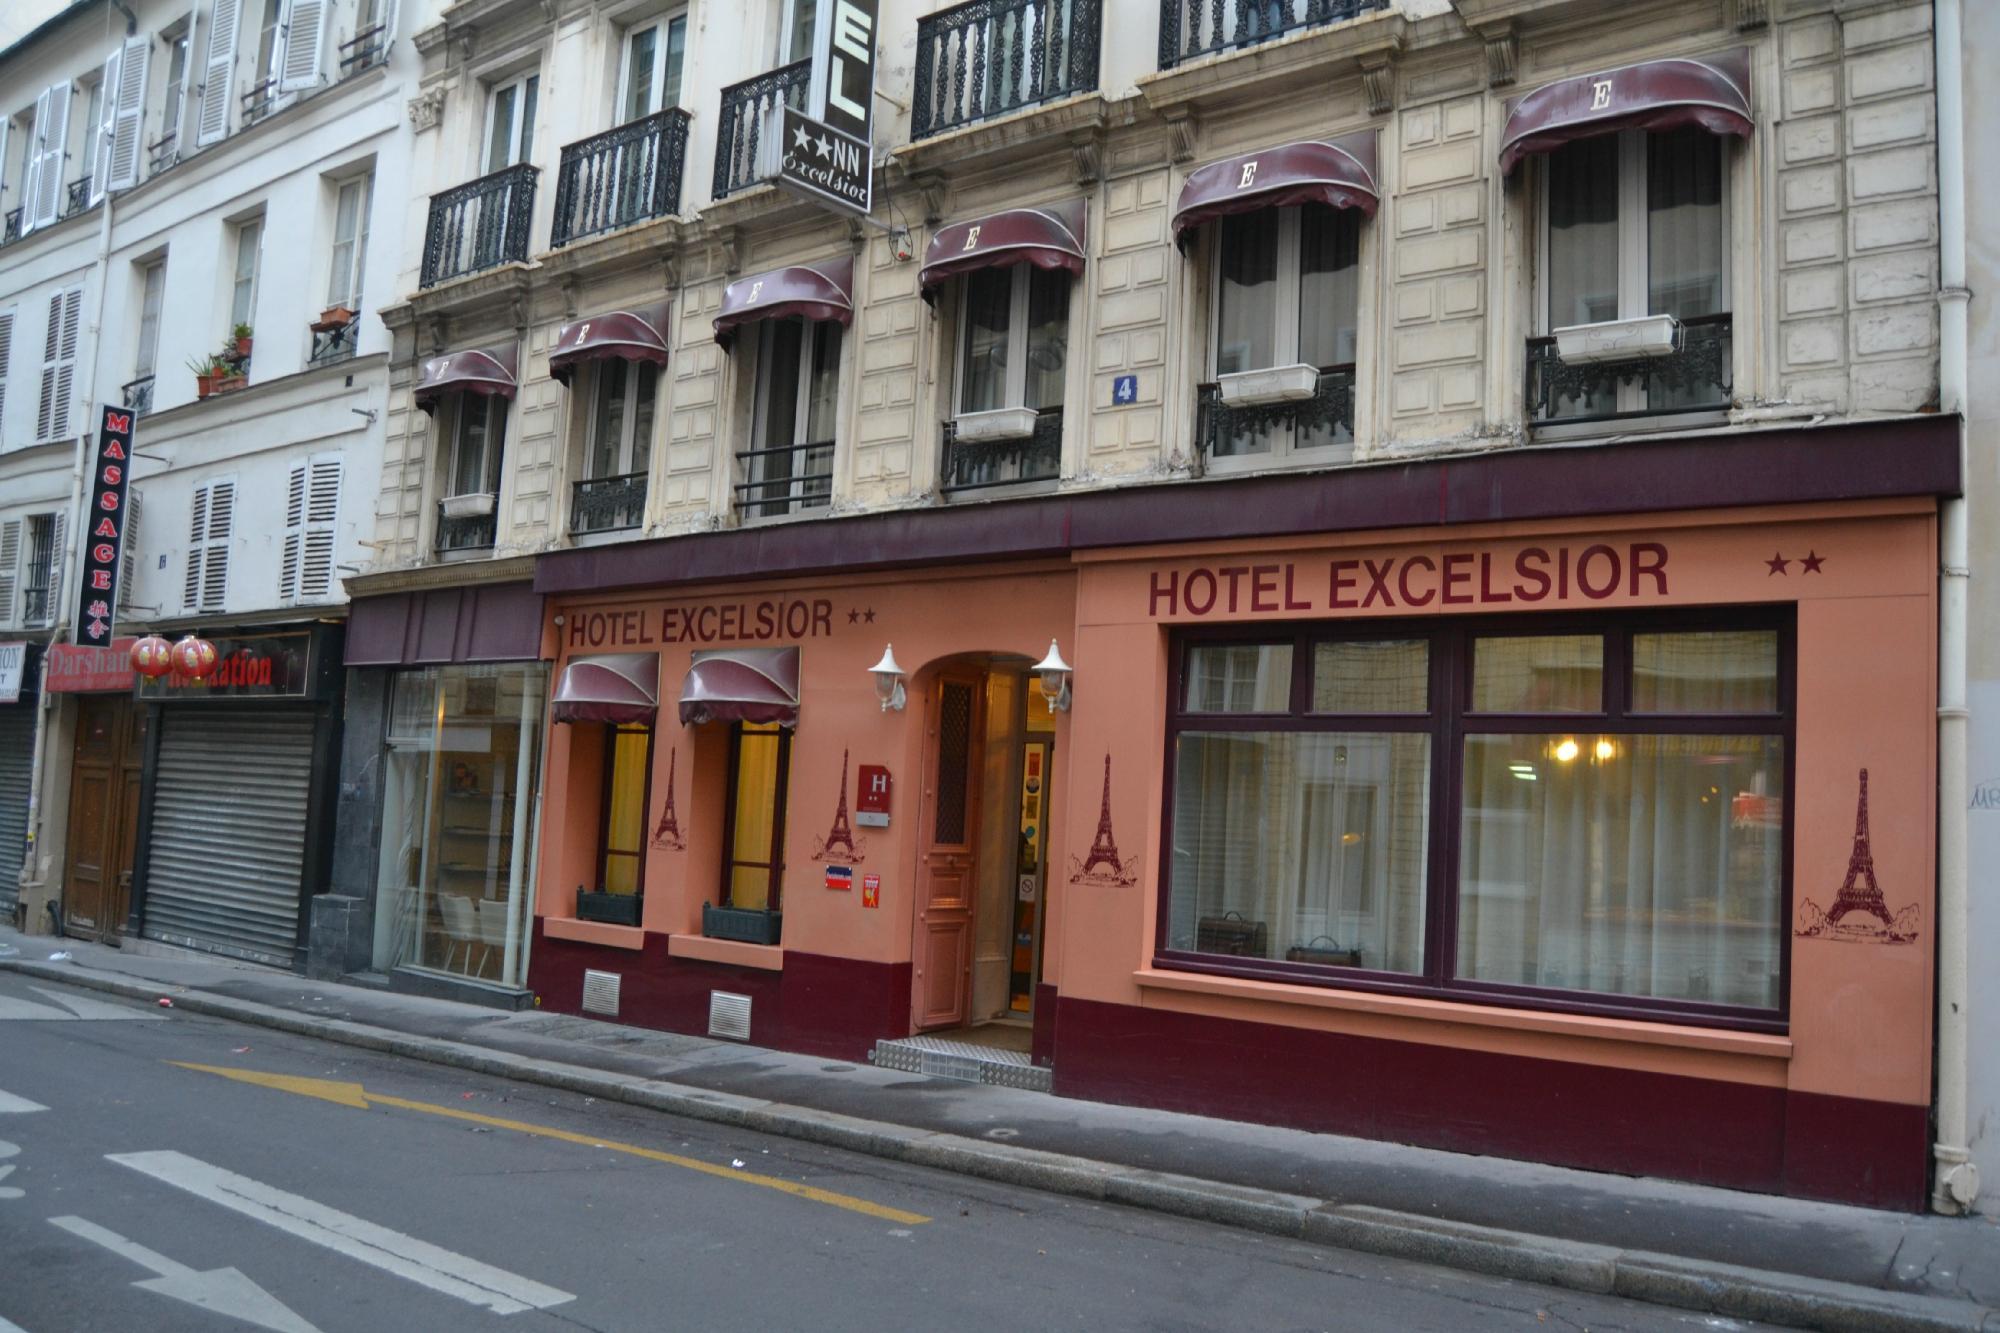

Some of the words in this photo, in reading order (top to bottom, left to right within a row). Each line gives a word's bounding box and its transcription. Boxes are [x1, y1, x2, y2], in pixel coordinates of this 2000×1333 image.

[1590, 80, 1612, 110] E
[833, 138, 860, 177] NN
[1237, 161, 1258, 189] E
[963, 226, 981, 251] E
[1118, 378, 1132, 400] 4
[92, 412, 130, 590] MASSAGE
[1150, 564, 1312, 617] HOTEL
[1328, 542, 1669, 610] EXCELSIOR
[569, 610, 653, 648] HOTEL
[661, 599, 833, 643] EXCELSIOR
[49, 649, 130, 676] Darshan
[872, 774, 887, 793] H
